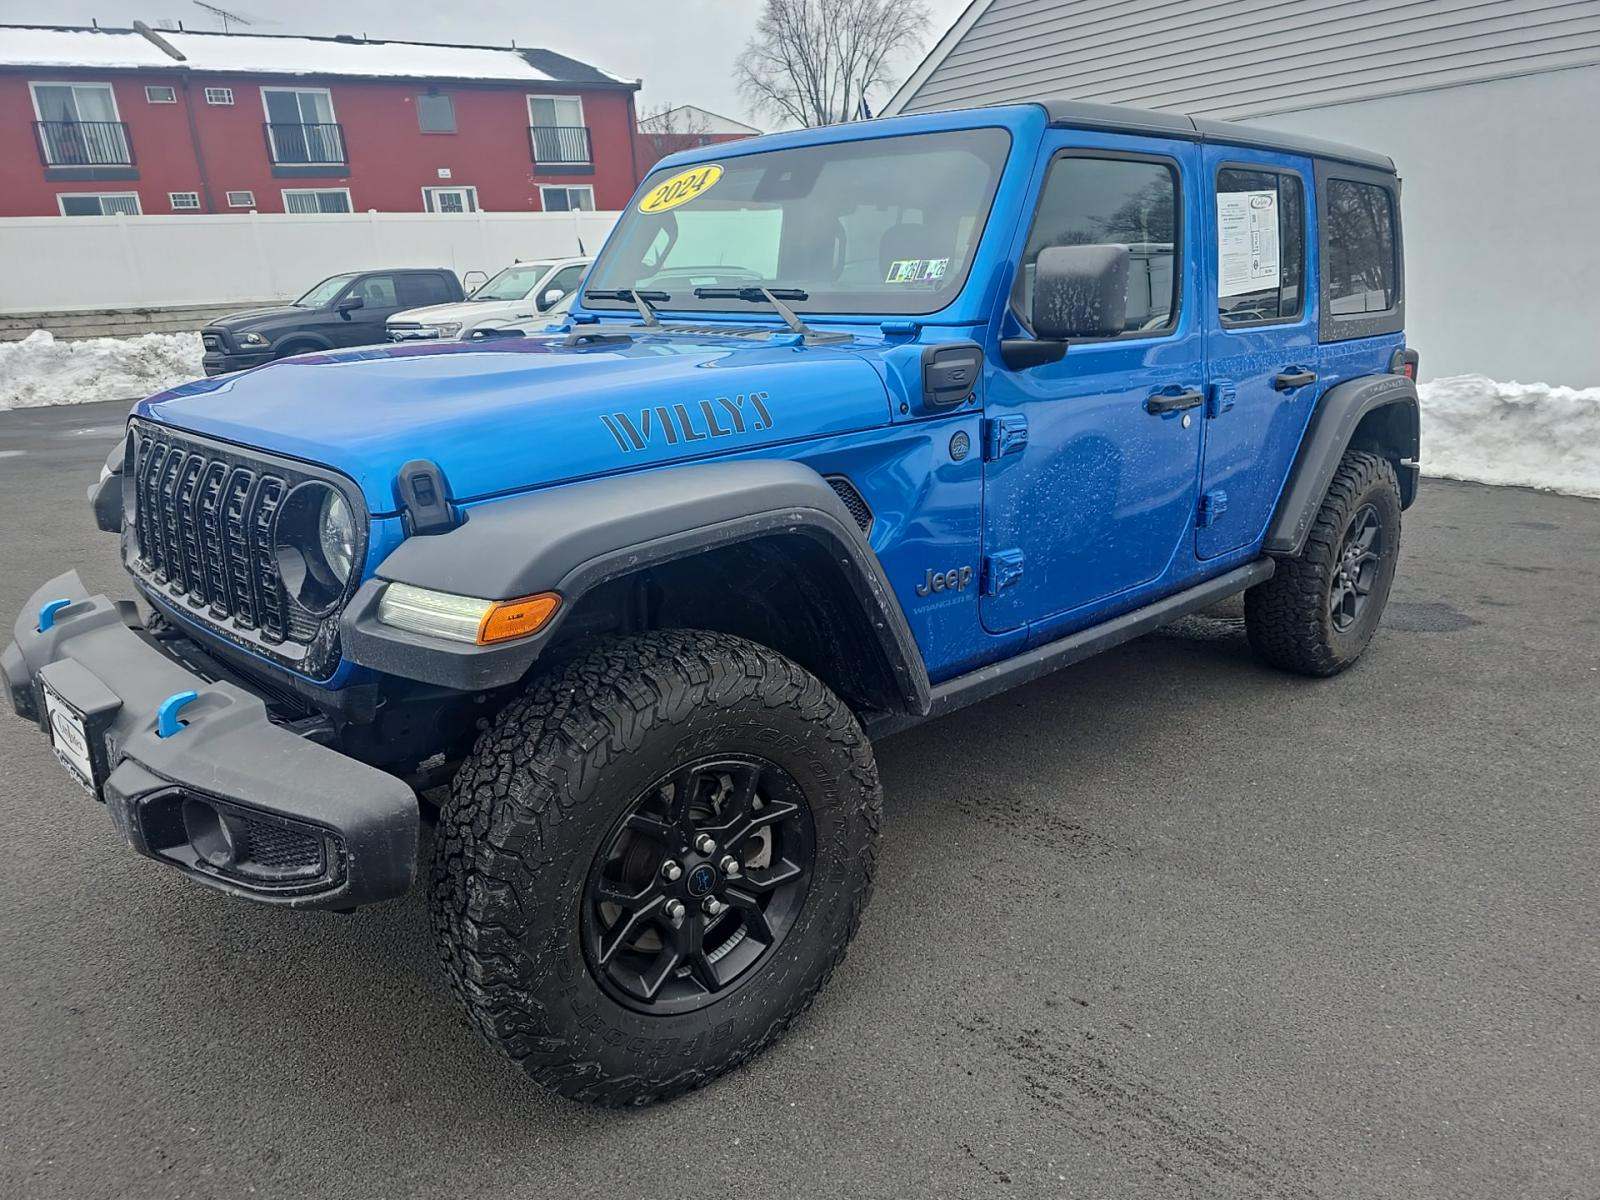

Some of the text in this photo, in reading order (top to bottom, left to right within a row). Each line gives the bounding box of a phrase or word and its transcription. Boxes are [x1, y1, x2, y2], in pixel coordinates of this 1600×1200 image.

[649, 169, 711, 209] 2024
[600, 391, 773, 452] WILLYS
[916, 566, 971, 596] Jeep
